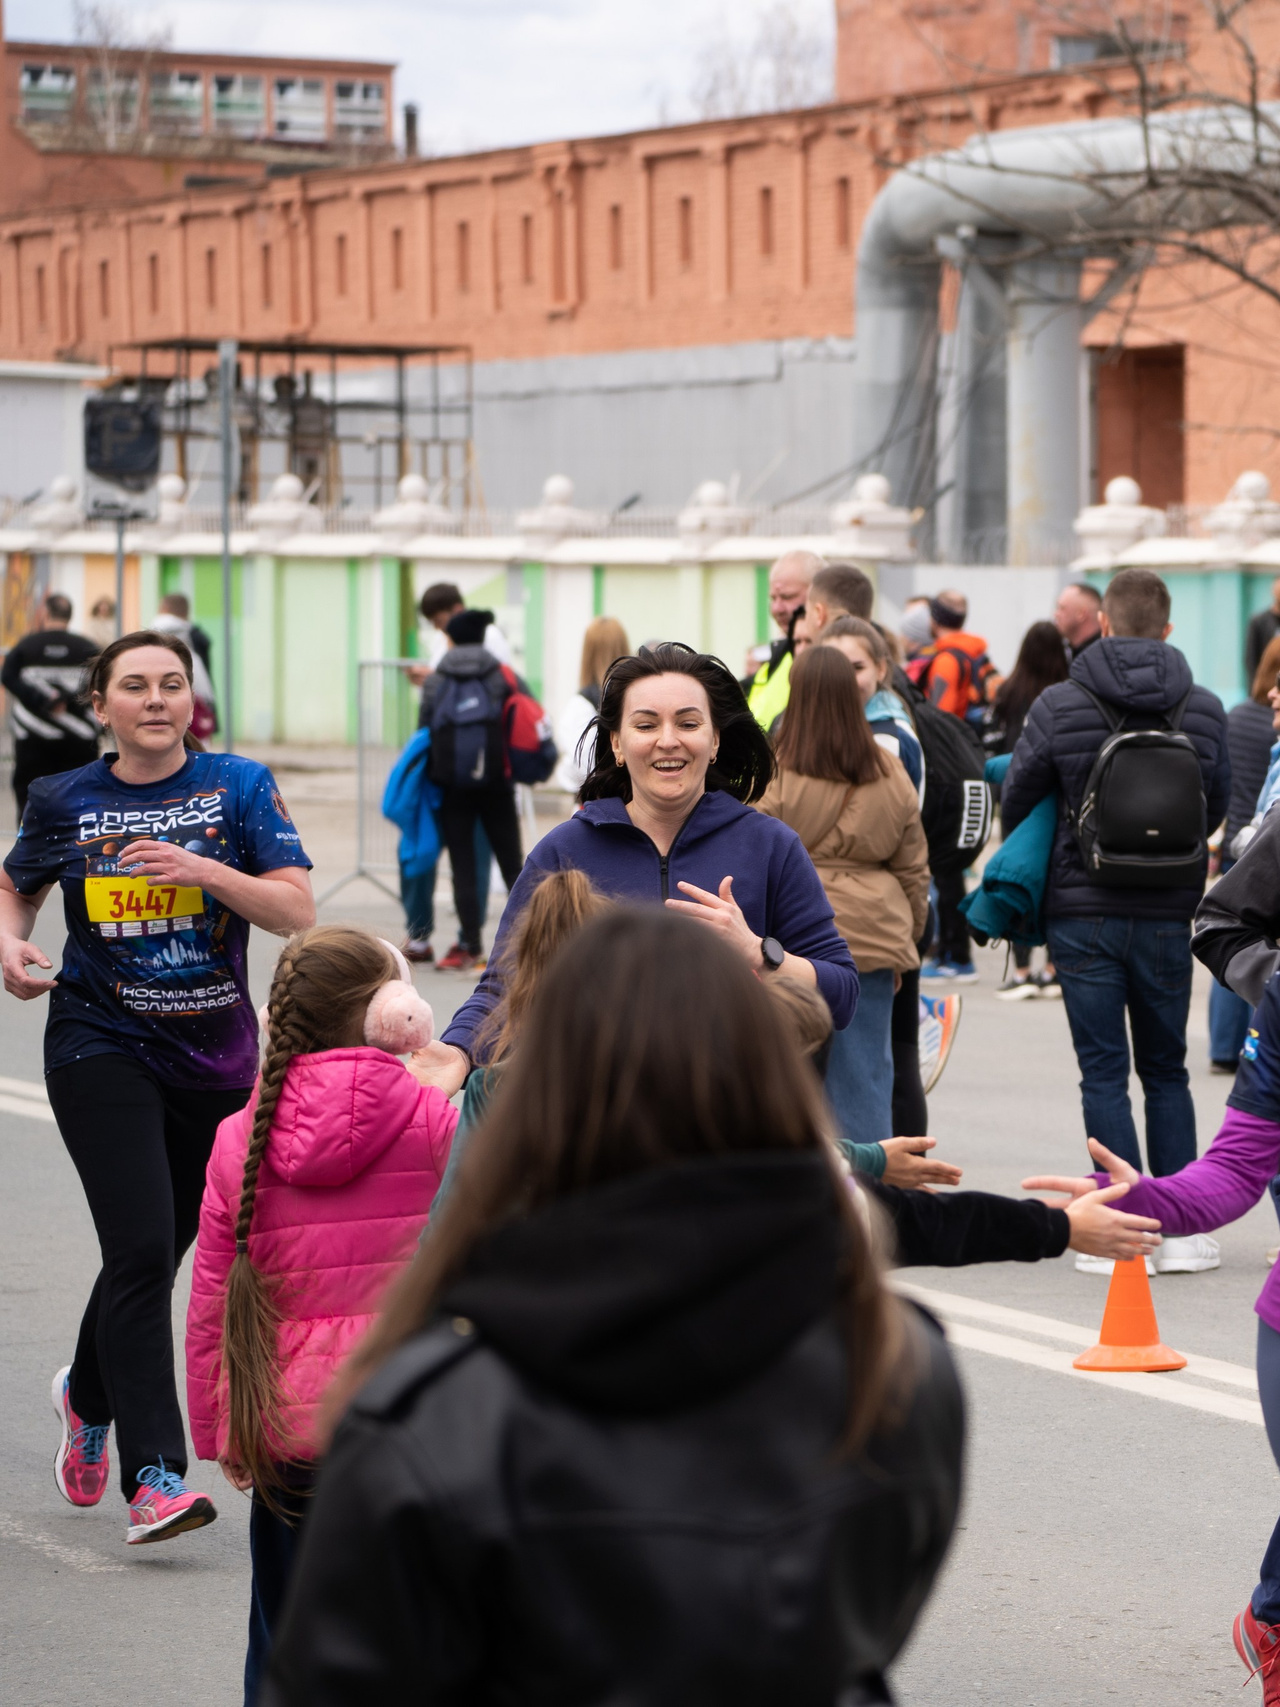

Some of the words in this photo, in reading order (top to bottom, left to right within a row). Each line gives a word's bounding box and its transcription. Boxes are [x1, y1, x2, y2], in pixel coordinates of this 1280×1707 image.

[78, 813, 98, 825] Я
[103, 793, 222, 823] ПРОСТО
[963, 785, 982, 844] PUMA
[109, 887, 178, 919] 3447
[123, 992, 241, 1012] ПОЛУМАРАФОН
